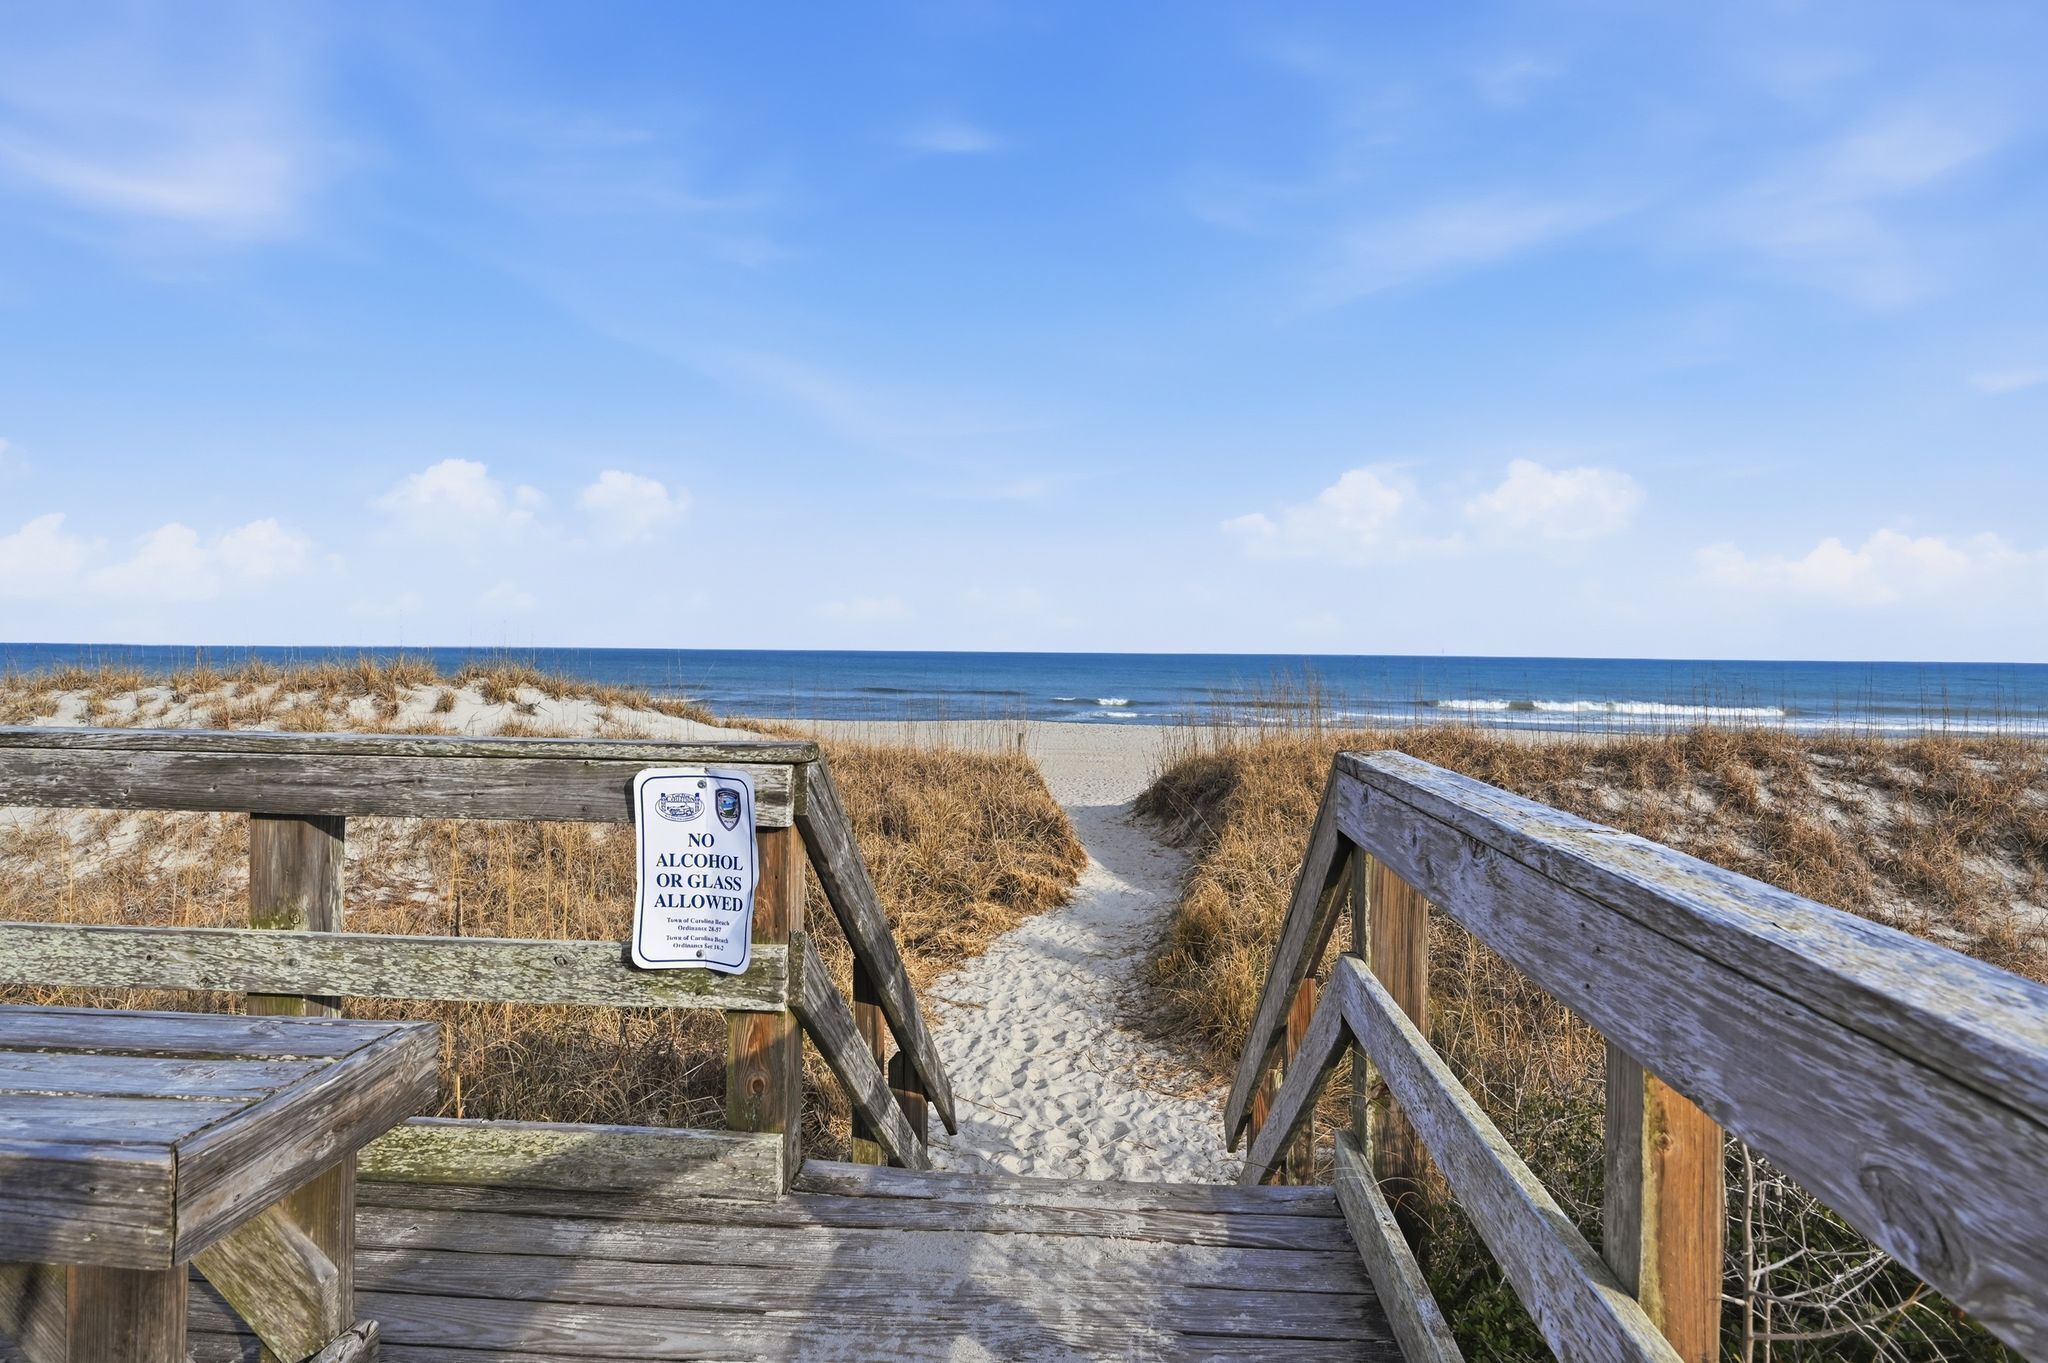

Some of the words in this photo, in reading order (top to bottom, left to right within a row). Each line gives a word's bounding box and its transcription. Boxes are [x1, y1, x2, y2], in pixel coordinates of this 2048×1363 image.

[688, 833, 715, 848] NO
[656, 853, 744, 871] ALCOHOL
[656, 873, 683, 888] OR
[687, 874, 742, 891] GLASS
[654, 893, 743, 912] ALLOWED
